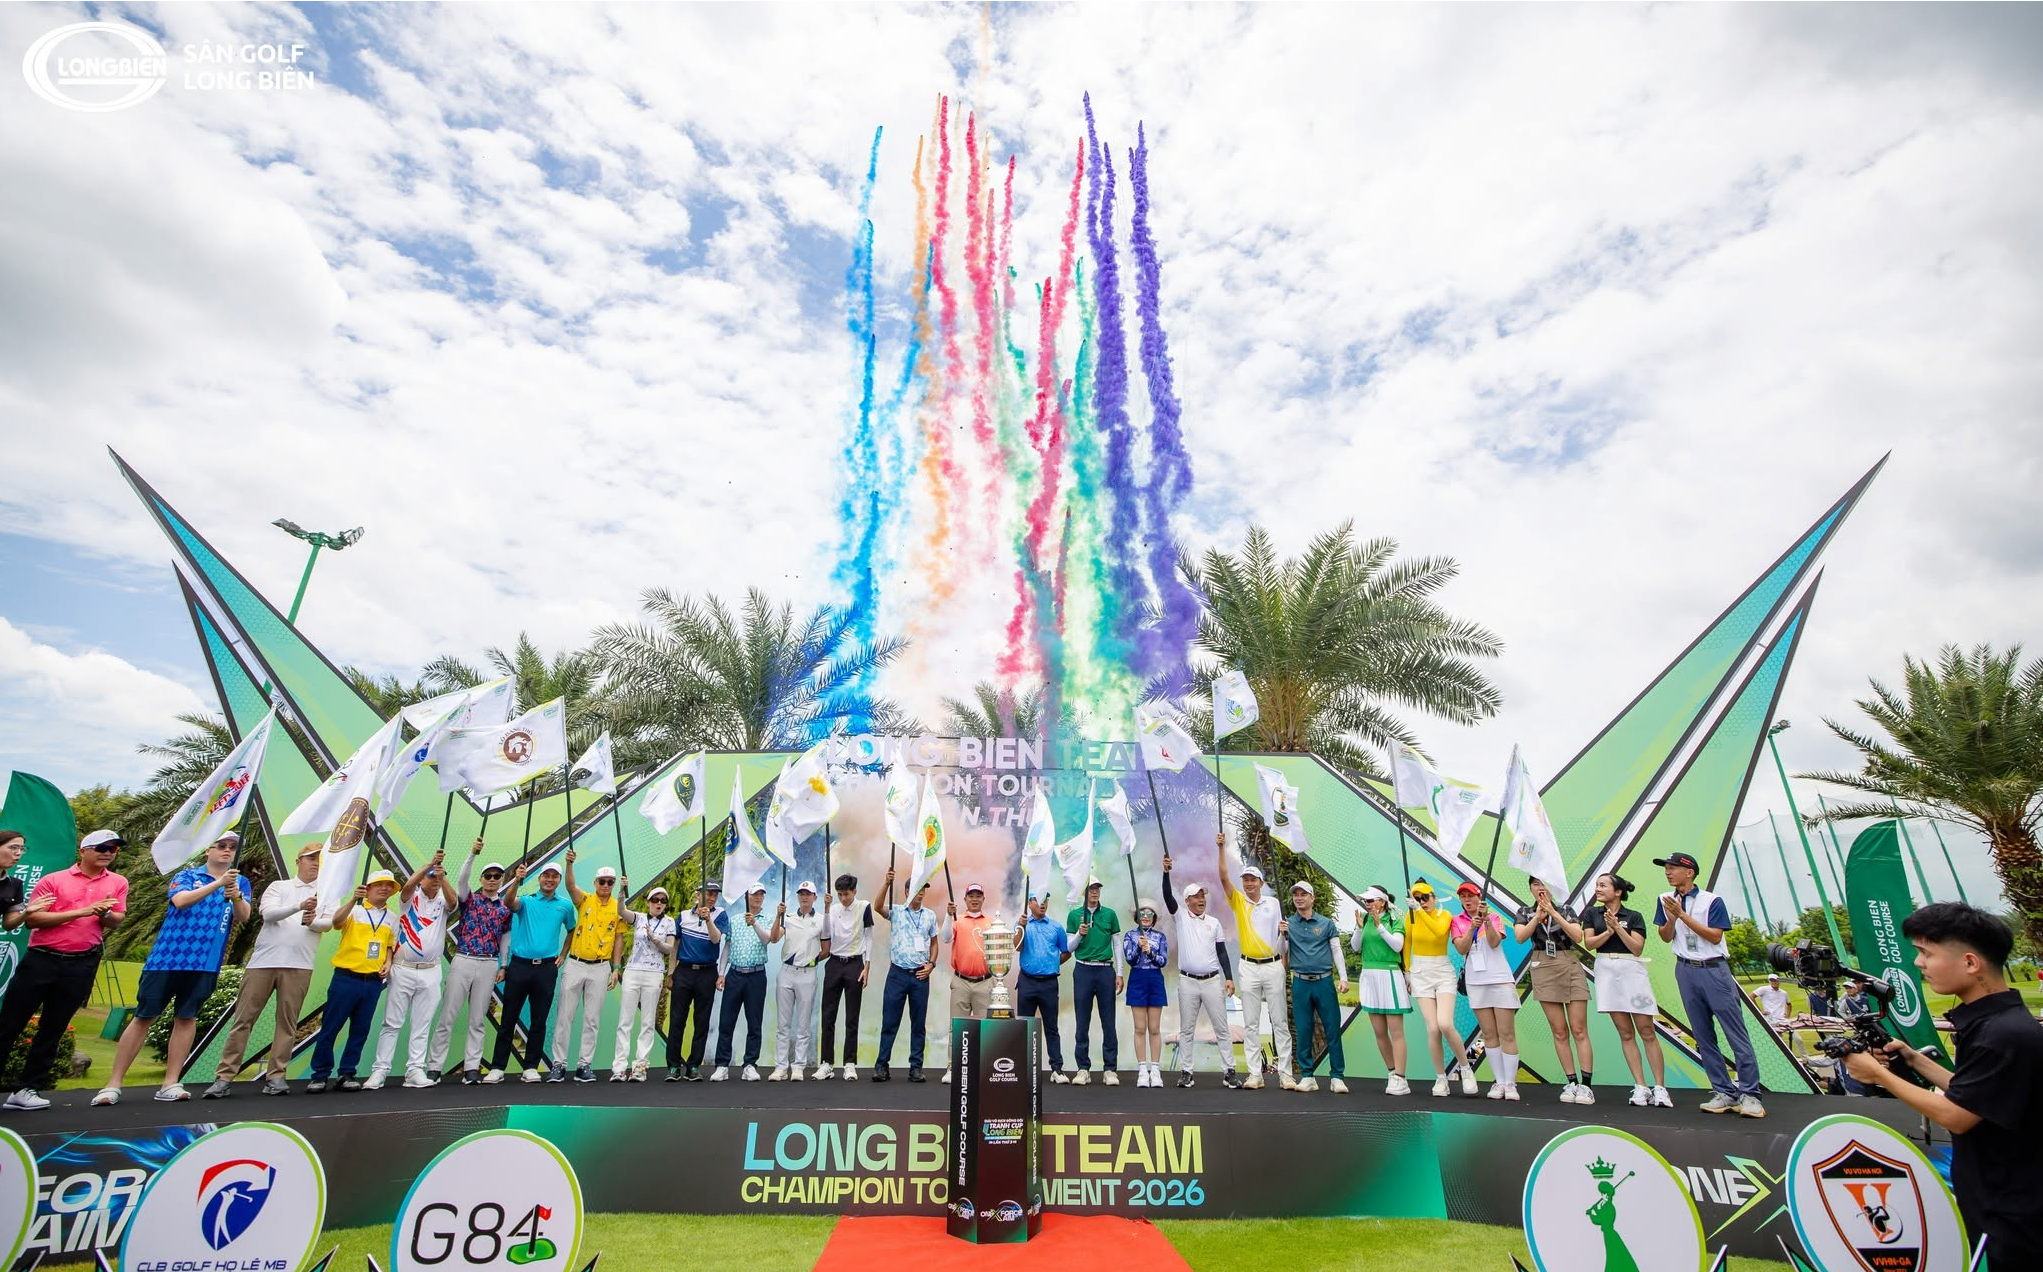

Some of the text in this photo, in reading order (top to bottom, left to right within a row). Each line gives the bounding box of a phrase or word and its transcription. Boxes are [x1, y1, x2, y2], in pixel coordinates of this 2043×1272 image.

[828, 732, 944, 767] LONG
[960, 737, 1043, 769] BIEN
[1868, 900, 1890, 963] LONG BIEN
[1880, 900, 1902, 963] GOLF COURSE
[961, 1031, 969, 1064] LONG
[960, 1095, 968, 1130] GOLF
[743, 1122, 896, 1172] LONG
[1042, 1125, 1205, 1174] TEAM
[958, 1131, 967, 1186] COURSE
[740, 1176, 904, 1205] CHAMPION
[1127, 1178, 1205, 1206] 2026
[410, 1202, 558, 1265] G84
[137, 1258, 287, 1272] CLB GOLF HỌ LÊ MB
